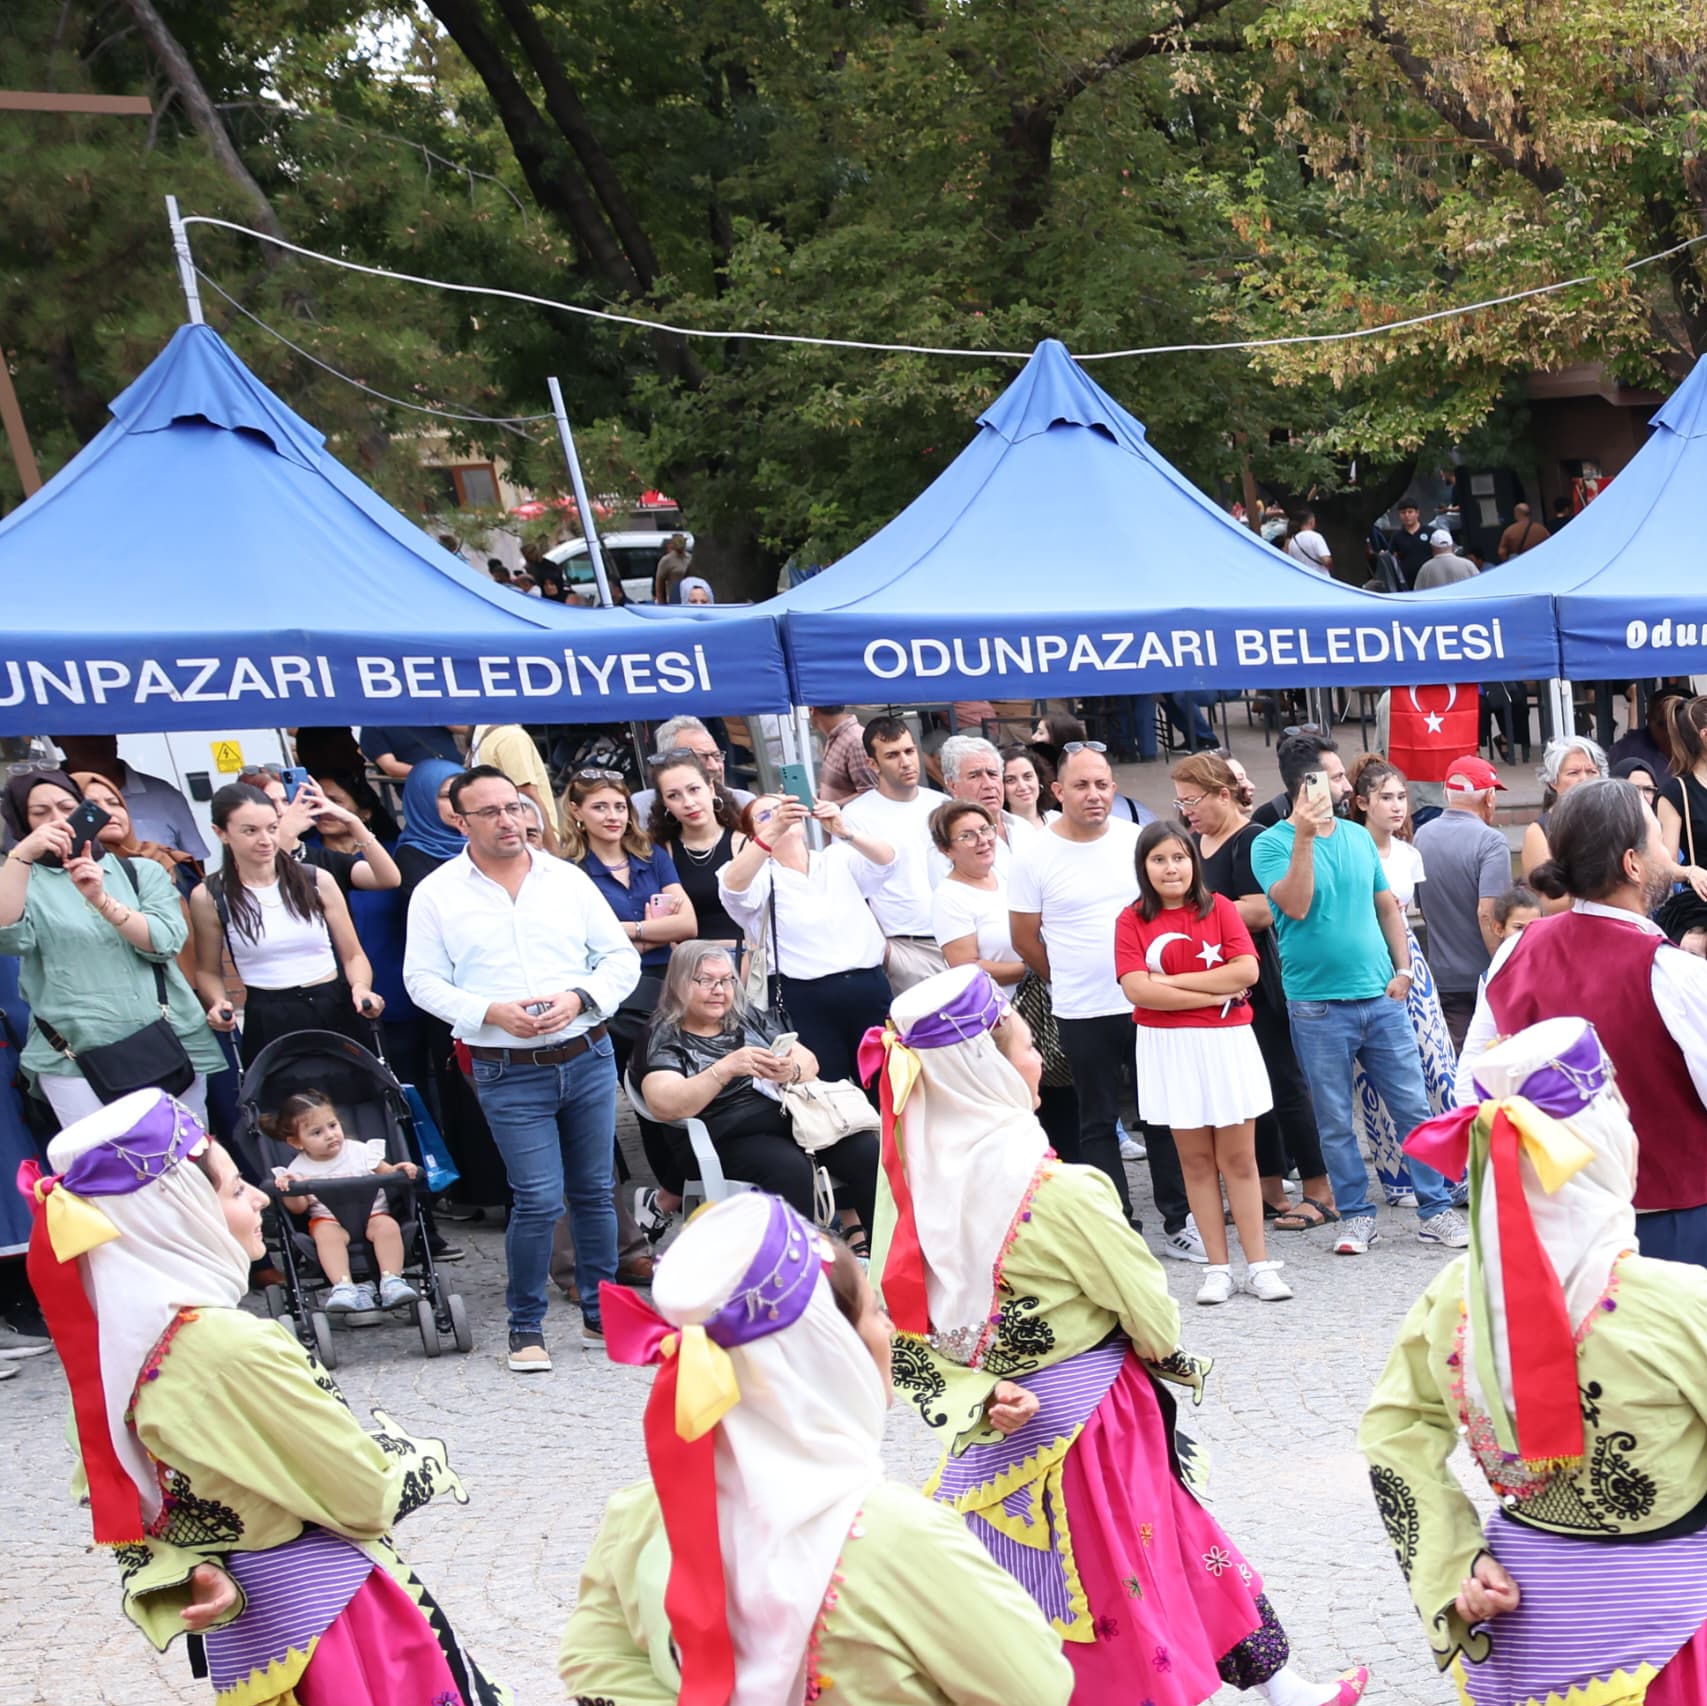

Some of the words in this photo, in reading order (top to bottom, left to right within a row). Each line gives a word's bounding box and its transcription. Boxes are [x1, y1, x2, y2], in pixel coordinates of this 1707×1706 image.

[356, 644, 712, 699] BELEDİYESİ
[863, 629, 1218, 679] ODUNPAZARI
[1234, 618, 1505, 667] BELEDİYESİ
